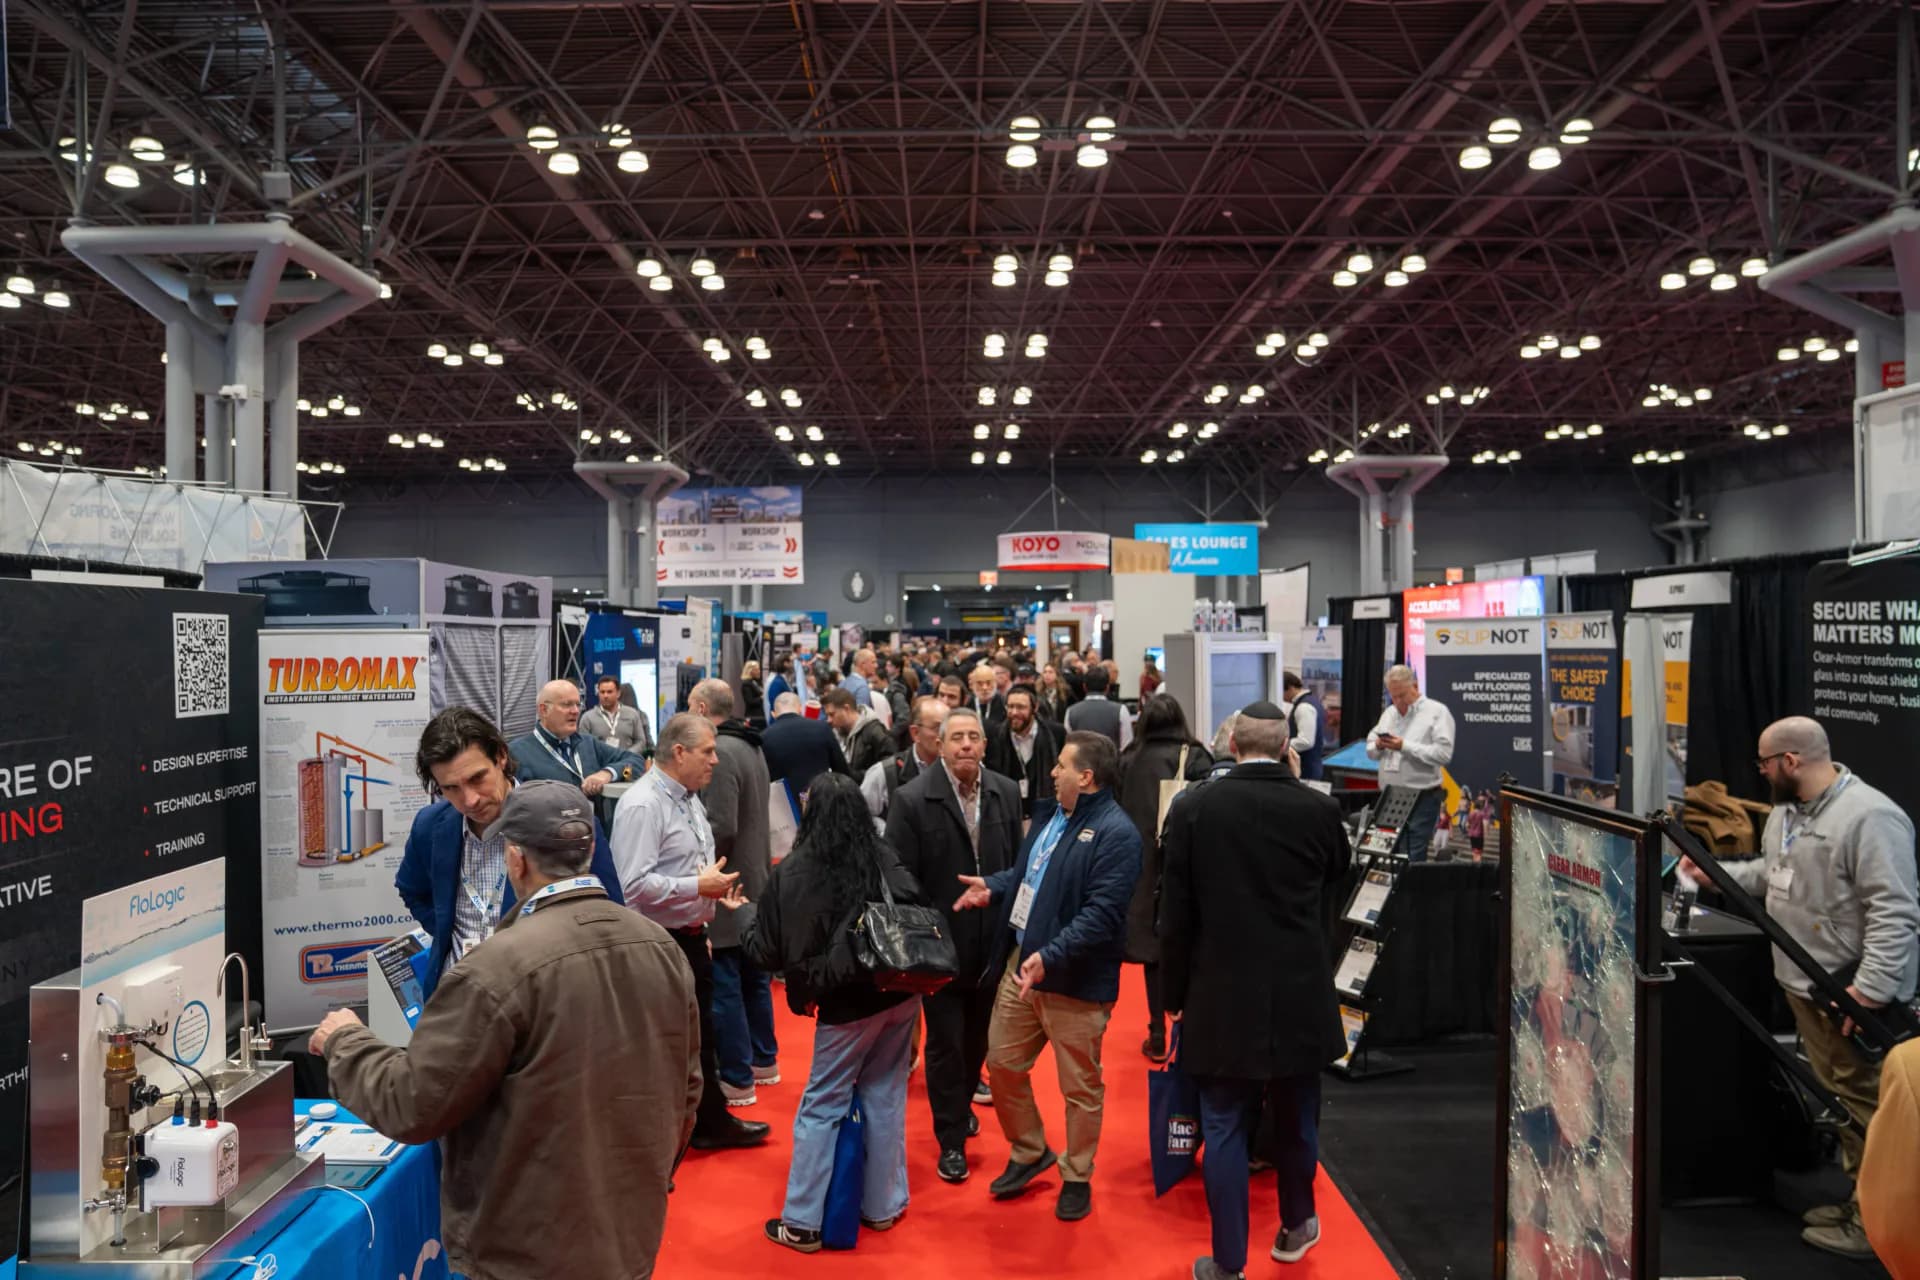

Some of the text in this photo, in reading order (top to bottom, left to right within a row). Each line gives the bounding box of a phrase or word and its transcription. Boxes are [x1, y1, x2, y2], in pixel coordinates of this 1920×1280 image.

[742, 527, 780, 536] WORKSHOP
[1012, 536, 1060, 553] KOYO
[1192, 536, 1248, 549] LOUNGE
[1813, 600, 1920, 621] SECURE WH
[1453, 628, 1530, 645] SLIPNOT
[1560, 621, 1608, 640] SLIPNOT
[1813, 624, 1895, 645] MATTERS
[1813, 651, 1862, 666] Clear-Armor
[1863, 653, 1913, 669] transforms
[268, 656, 419, 692] TURBOMAX
[1474, 671, 1531, 681] SPECIALIZED
[1550, 668, 1608, 685] THE SAFEST
[1859, 672, 1889, 686] robust
[1889, 674, 1918, 688] shield
[1451, 682, 1531, 692] SAFETY FLOORING
[1561, 686, 1596, 701] CHOICE
[328, 694, 360, 702] INDIRECT
[361, 693, 386, 701] WATER
[387, 692, 413, 700] HEATER
[1462, 692, 1531, 702] PRODUCTS AND
[1848, 692, 1868, 704] your
[1490, 703, 1531, 712] SURFACE
[1814, 705, 1830, 717] and
[1464, 713, 1532, 723] TECHNOLOGIES
[153, 746, 248, 773] DESIGN EXPERTISE
[47, 755, 93, 789] OF
[154, 782, 257, 815] TECHNICAL SUPPORT
[156, 832, 206, 857] TRAINING
[1572, 862, 1601, 887] ARMOR
[274, 914, 419, 936] www.thermo2000.co
